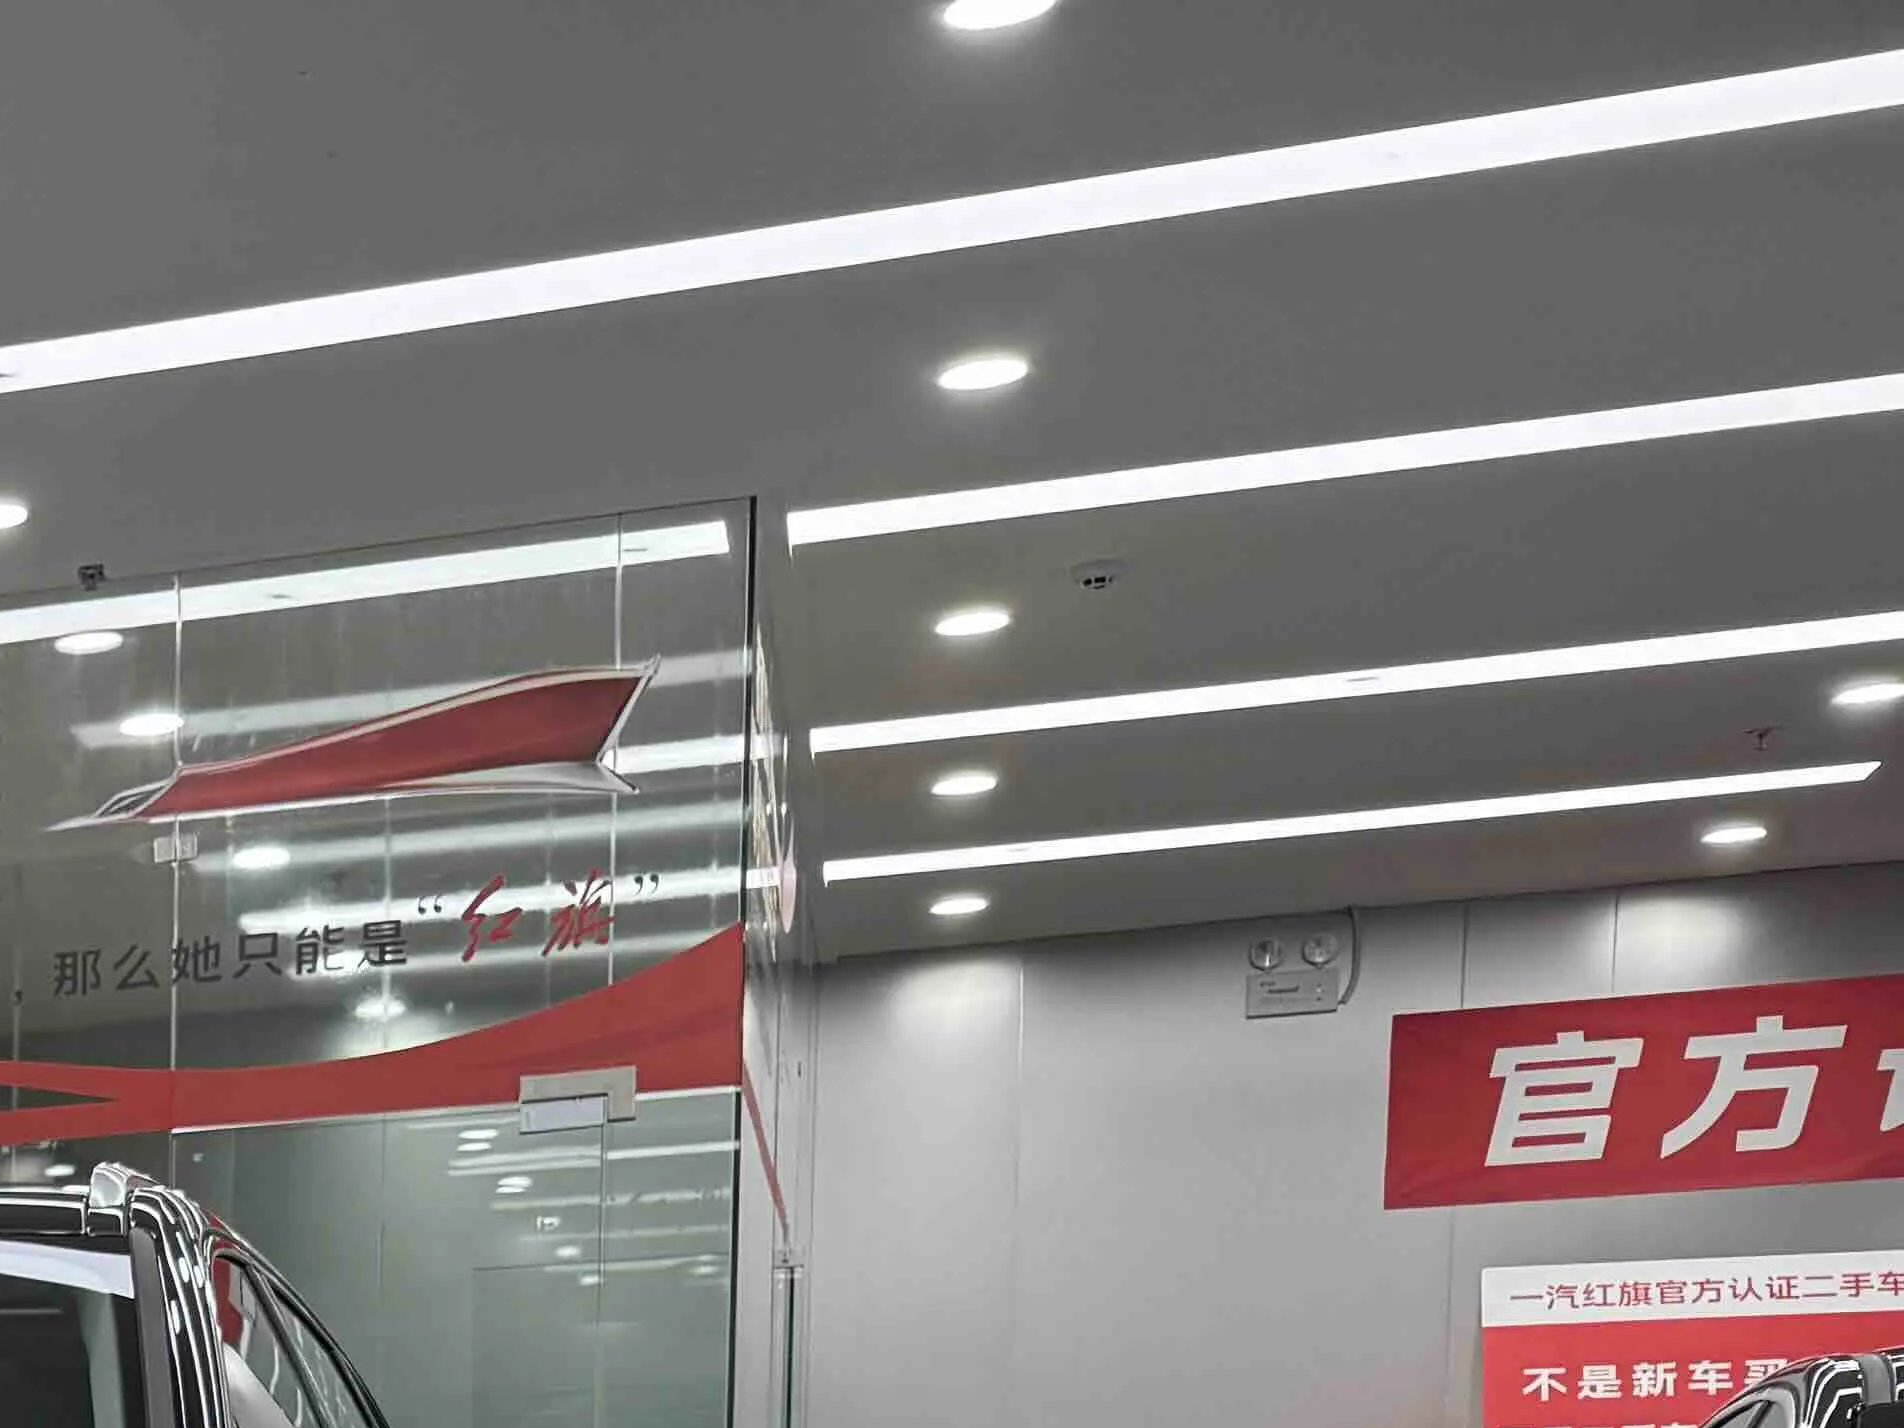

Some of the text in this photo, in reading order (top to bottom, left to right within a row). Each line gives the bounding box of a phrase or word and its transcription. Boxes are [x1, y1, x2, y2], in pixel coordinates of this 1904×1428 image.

[1484, 1015, 1904, 1167] 官方
[1509, 1270, 1904, 1310] 一汽红旗官方认证二手车
